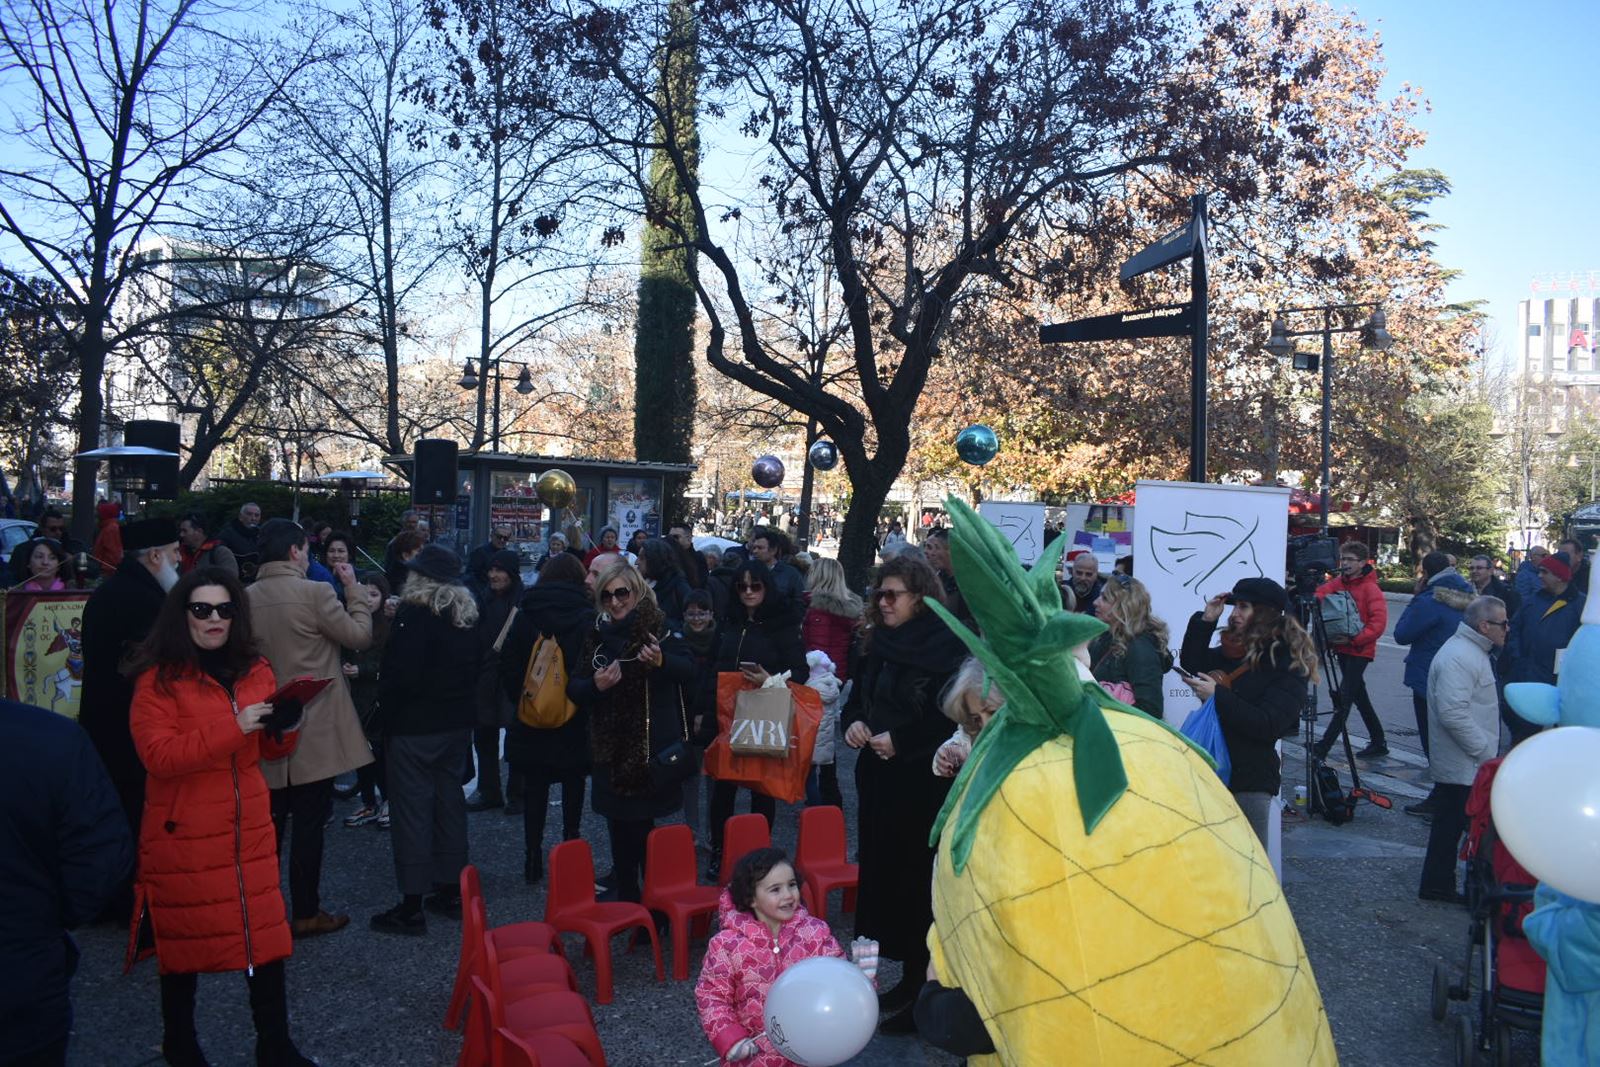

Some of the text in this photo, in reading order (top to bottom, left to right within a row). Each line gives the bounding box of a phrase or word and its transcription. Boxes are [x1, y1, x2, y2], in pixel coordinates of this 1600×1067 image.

[1121, 307, 1183, 322] Δικαστικό Μέγαρο
[729, 719, 787, 747] ZARA
